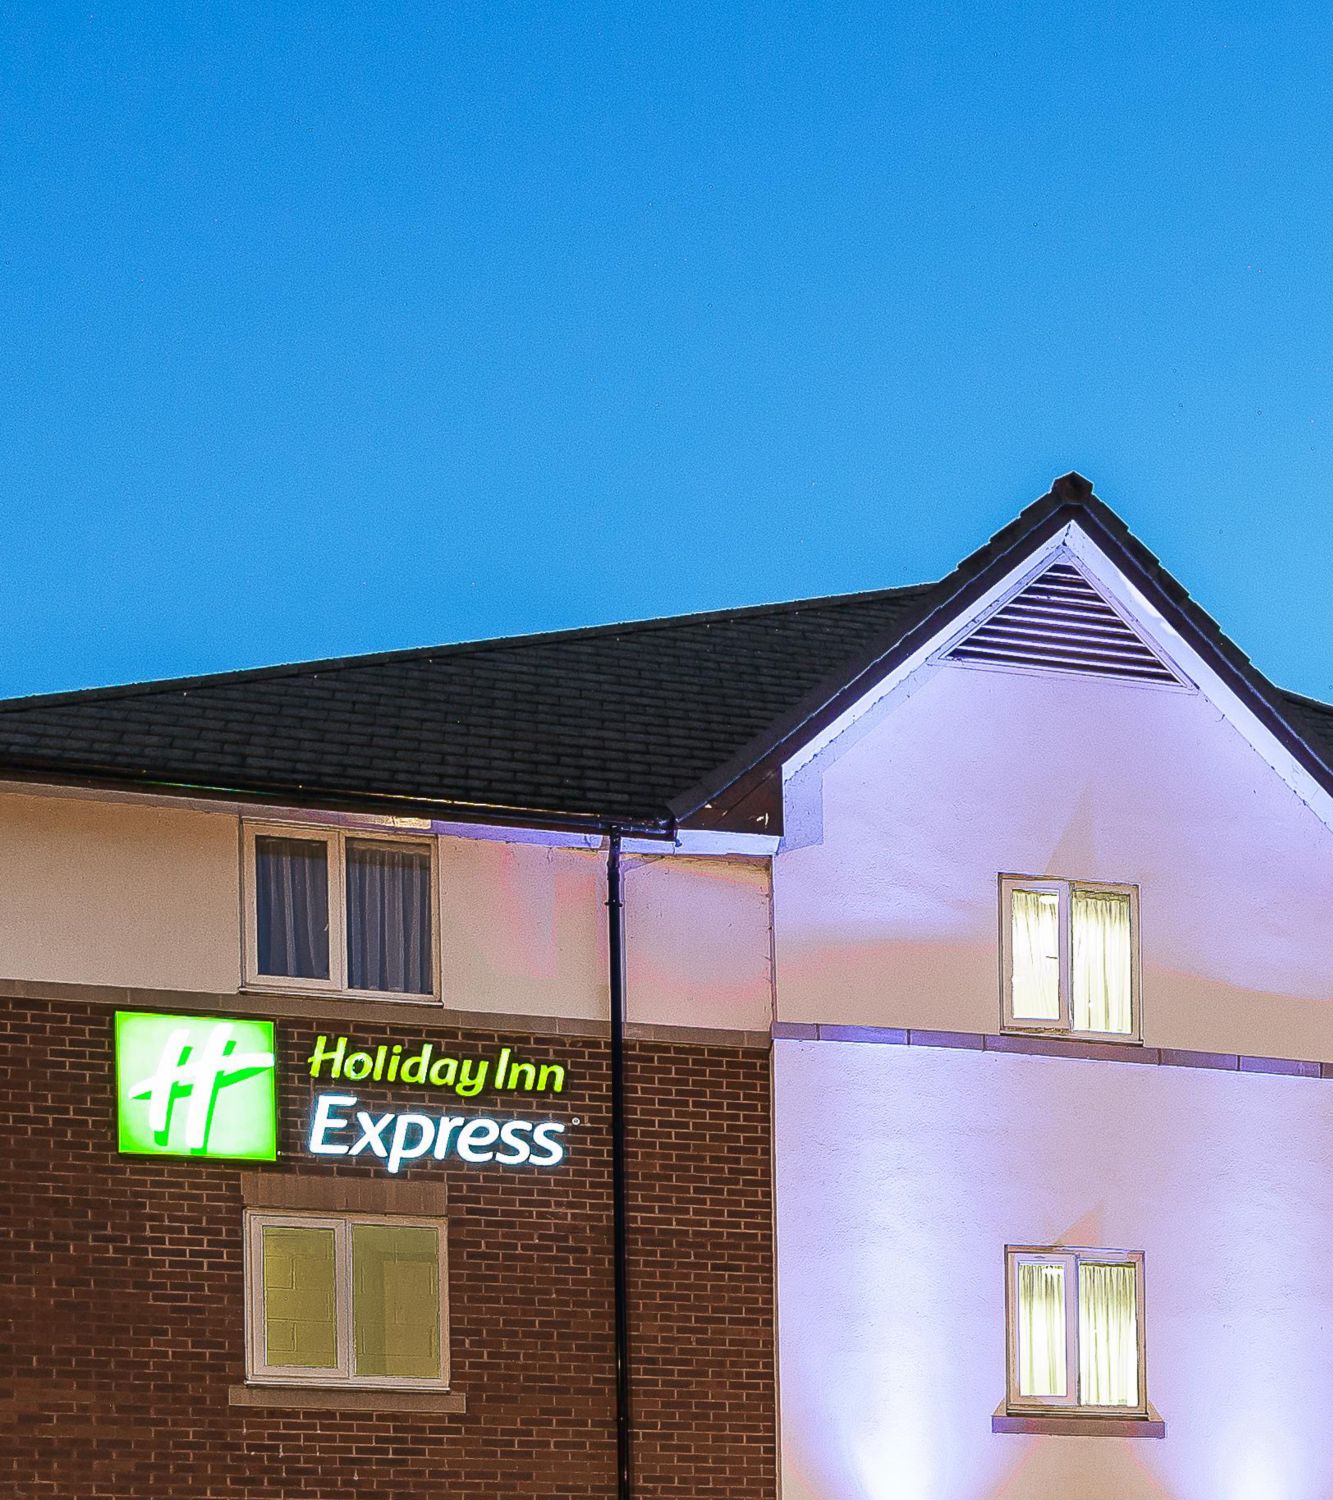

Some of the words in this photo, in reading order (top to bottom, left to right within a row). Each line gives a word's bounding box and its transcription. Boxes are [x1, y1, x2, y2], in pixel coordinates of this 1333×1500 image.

[308, 1035, 488, 1096] Holiday
[495, 1048, 566, 1093] Inn
[310, 1096, 566, 1173] Express
